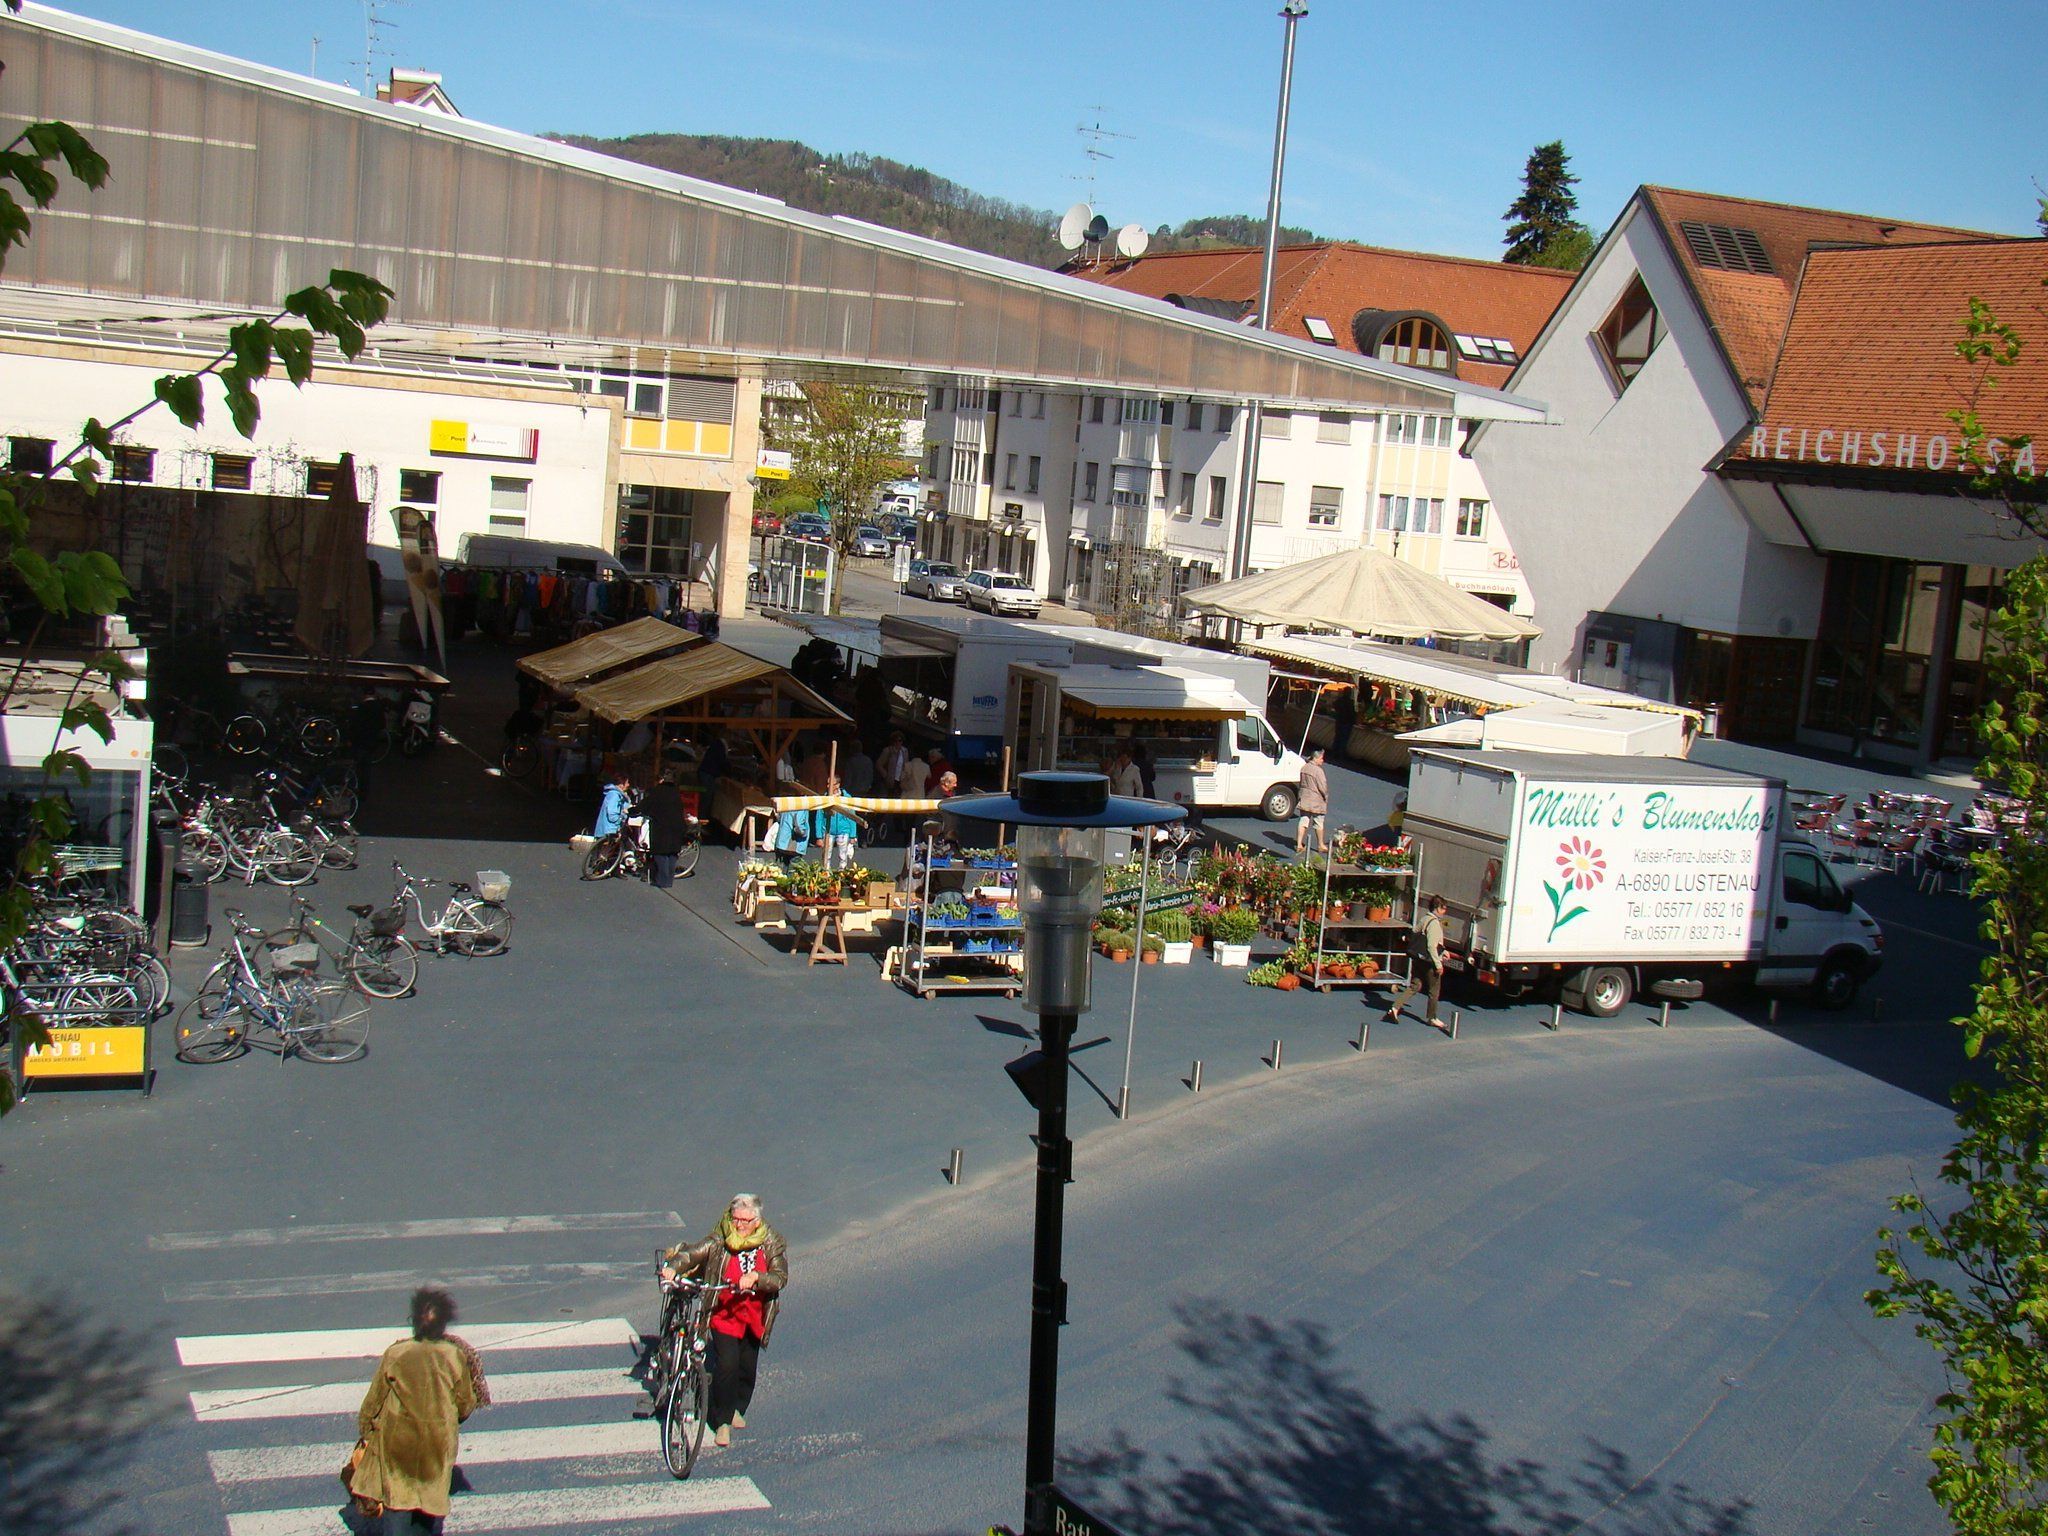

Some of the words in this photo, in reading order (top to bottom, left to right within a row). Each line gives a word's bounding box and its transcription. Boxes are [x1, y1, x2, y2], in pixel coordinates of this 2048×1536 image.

[1455, 582, 1516, 593] Buchhandlung
[1642, 791, 1775, 840] Blumenshop
[1634, 849, 1738, 864] Kaiser-Franz-Josef-Str.
[1740, 850, 1751, 864] 38
[1615, 873, 1670, 892] A-6890
[1675, 874, 1760, 892] LUSTENAU
[1627, 902, 1650, 918] Tel.:
[1655, 902, 1692, 918] 05577
[1703, 902, 1725, 918] 852
[1730, 902, 1743, 918] 16
[1623, 926, 1644, 940] Fax
[1646, 926, 1681, 940] 05577
[1689, 926, 1709, 940] 832
[1712, 926, 1725, 940] 73
[1735, 926, 1742, 938] 4
